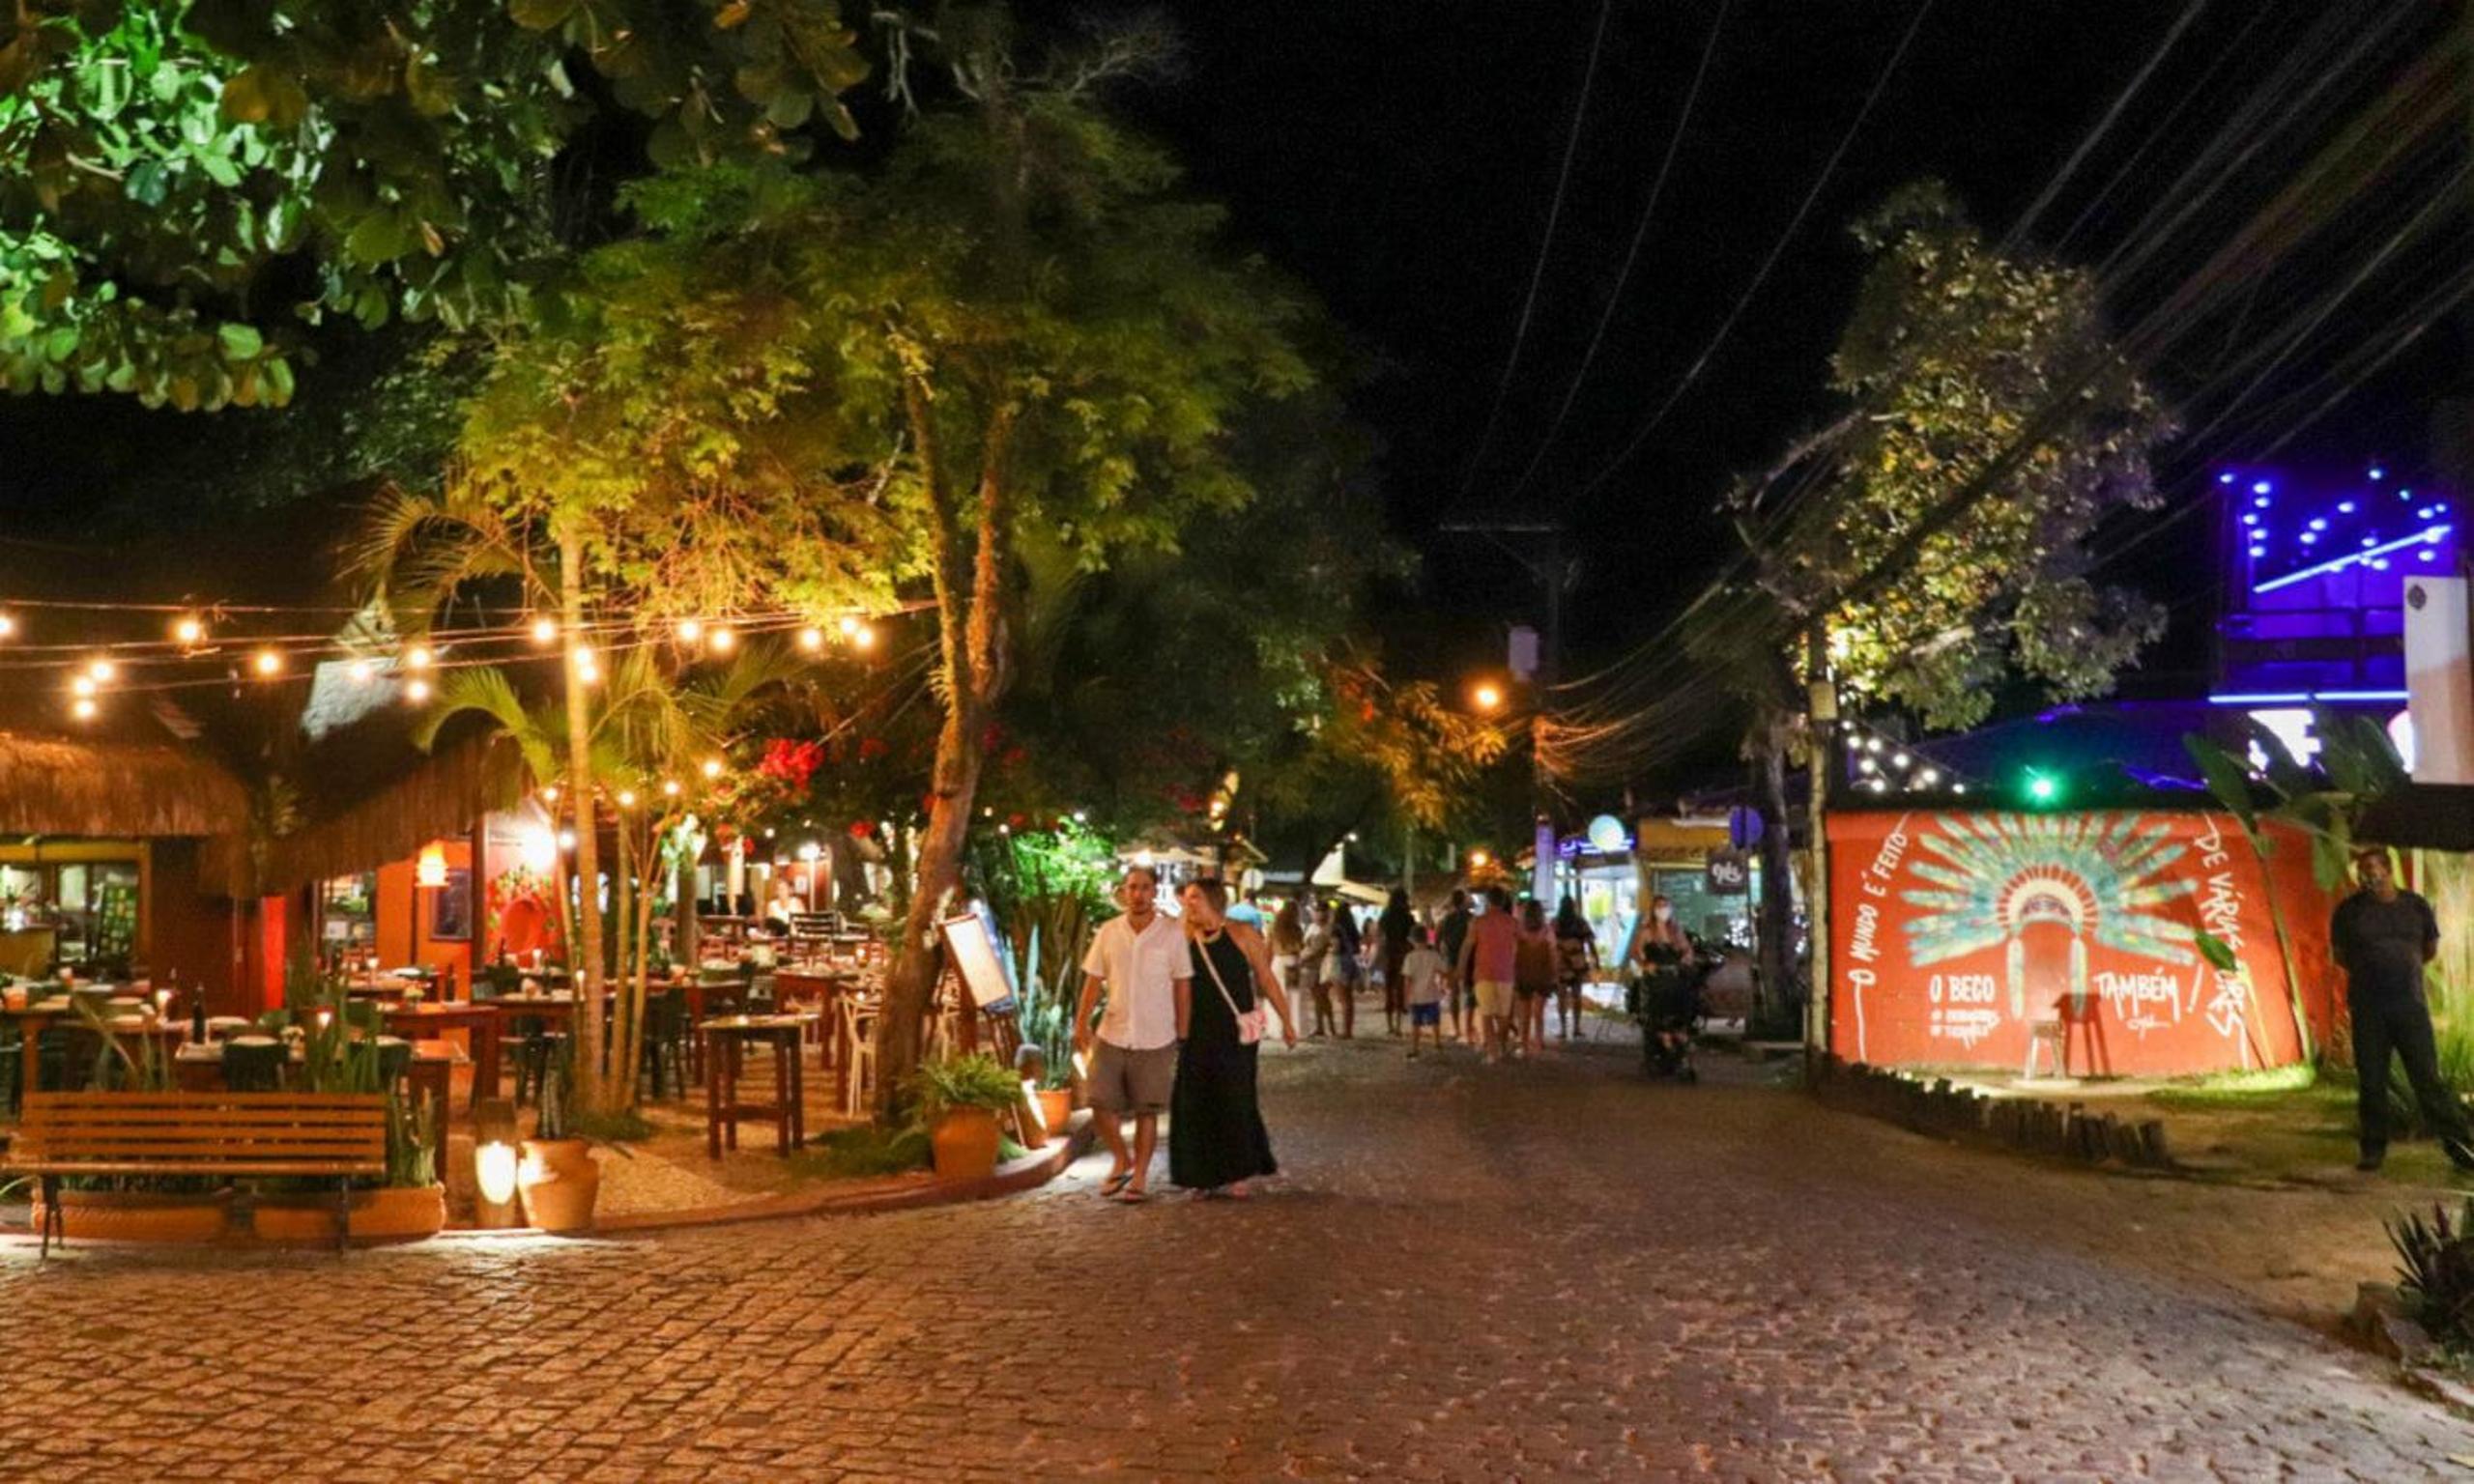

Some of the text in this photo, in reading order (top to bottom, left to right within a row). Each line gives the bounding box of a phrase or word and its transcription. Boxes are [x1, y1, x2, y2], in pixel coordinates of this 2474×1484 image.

[2194, 833, 2229, 870] DE
[1848, 833, 1908, 985] O MUNDO É FEITO
[1930, 973, 1942, 1003] O
